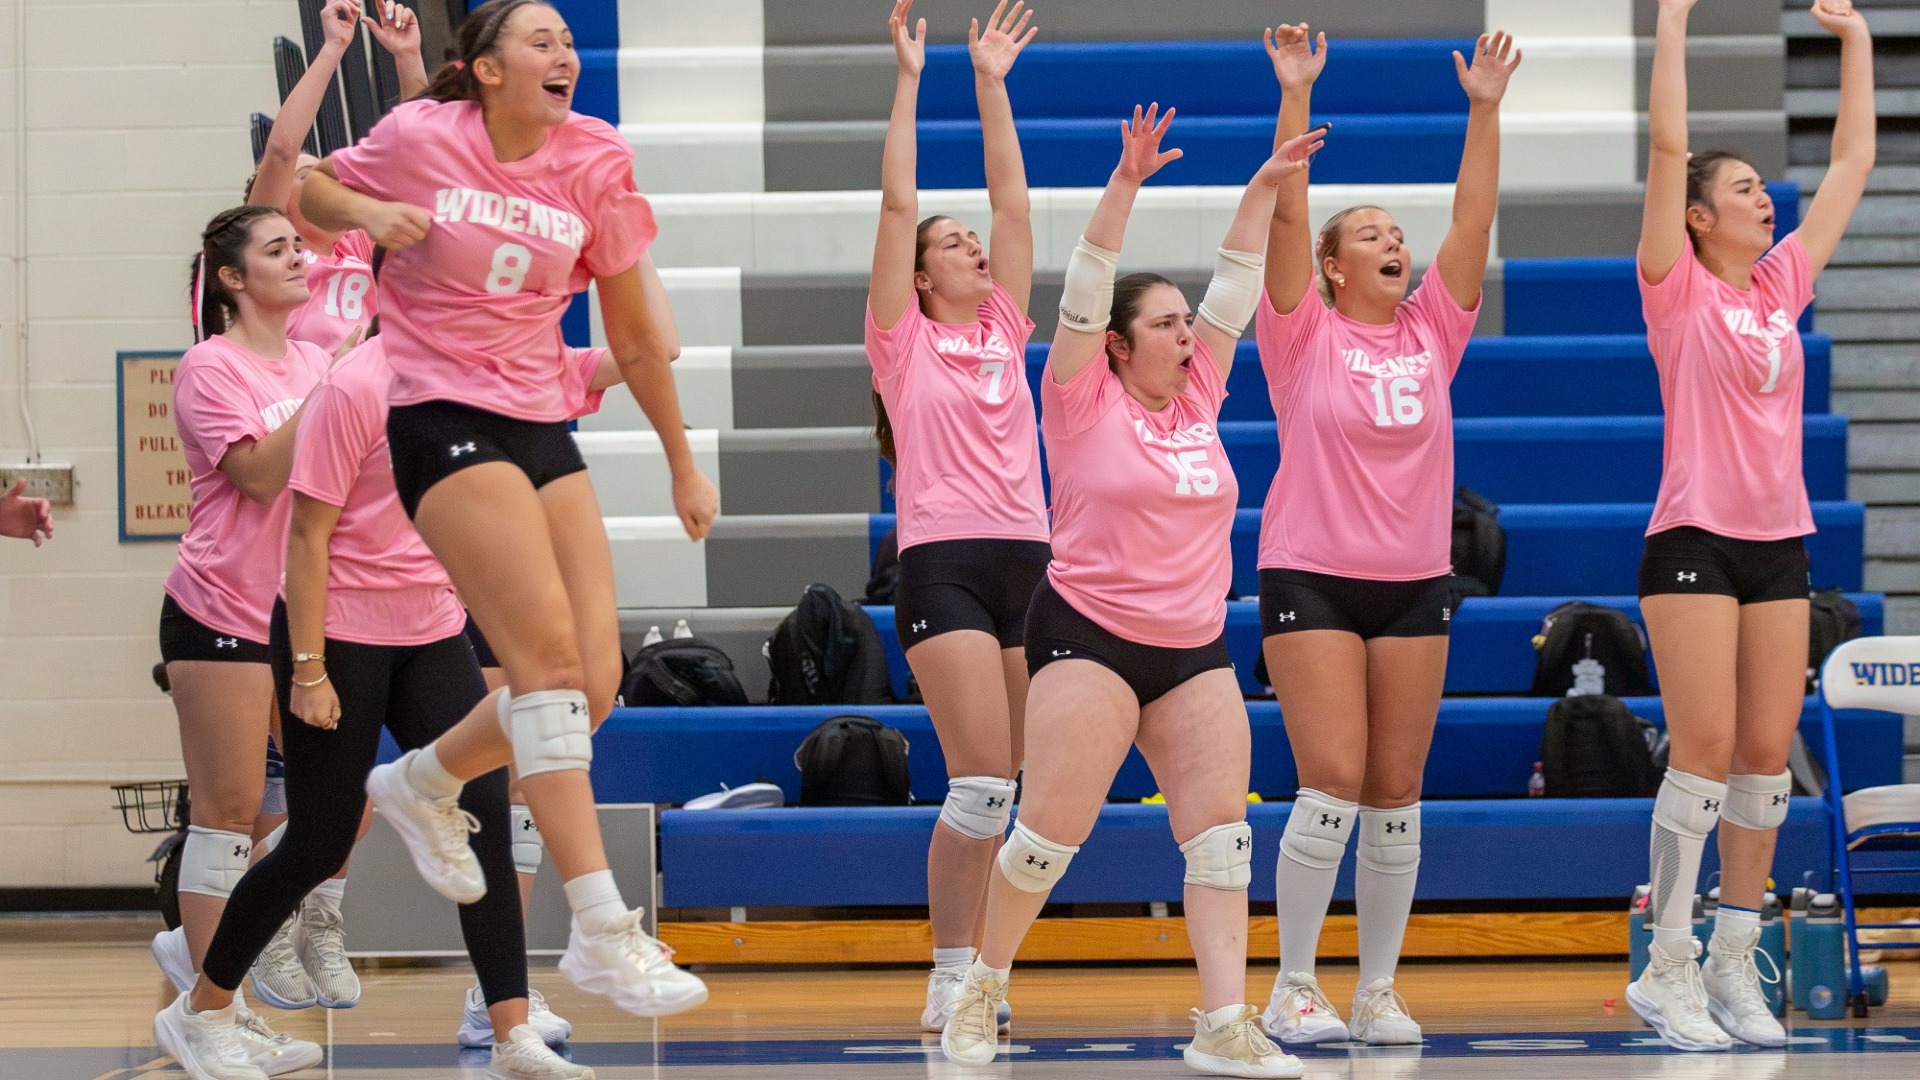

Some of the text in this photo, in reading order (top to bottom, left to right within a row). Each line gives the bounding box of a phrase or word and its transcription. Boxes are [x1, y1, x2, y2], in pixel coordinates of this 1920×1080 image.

[434, 187, 586, 251] WIDENER
[485, 242, 532, 295] 8
[325, 270, 371, 320] 18
[977, 361, 1005, 405] 7
[1759, 346, 1781, 393] 1
[148, 402, 168, 418] DO
[260, 398, 305, 432] WID
[1370, 376, 1424, 427] 16
[139, 436, 178, 452] PULL
[1167, 449, 1219, 496] 15
